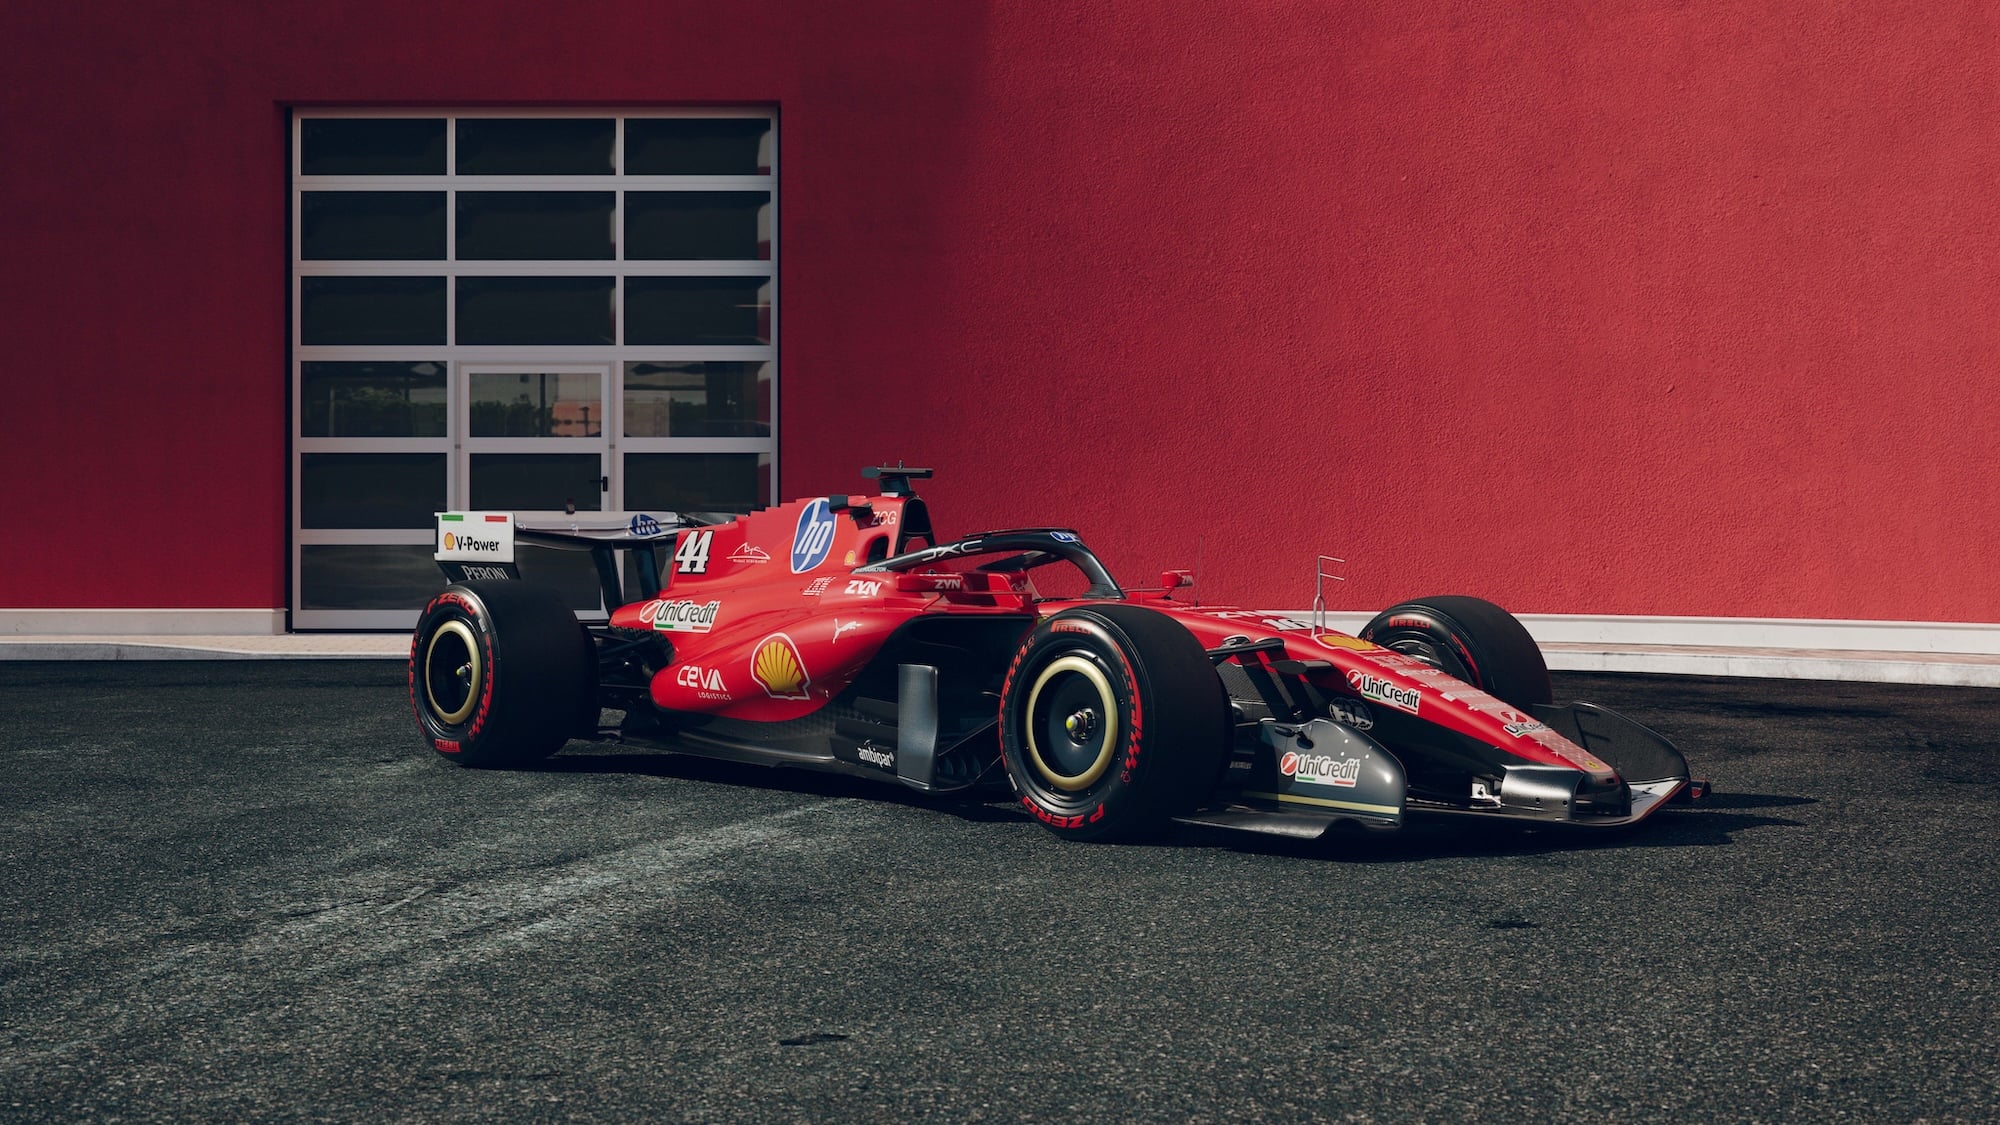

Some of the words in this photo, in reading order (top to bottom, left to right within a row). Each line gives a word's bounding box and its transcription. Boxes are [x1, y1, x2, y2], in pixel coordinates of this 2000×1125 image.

[871, 511, 897, 525] ZCG
[456, 536, 499, 551] V-Power
[795, 499, 832, 571] hp
[675, 530, 713, 573] 44
[461, 565, 510, 581] PERONI
[845, 580, 881, 597] ZYN
[934, 579, 961, 590] ZYN
[656, 602, 718, 625] UniCredit
[1389, 615, 1431, 629] PIRELLI
[1051, 619, 1092, 635] PIRELLI
[697, 691, 732, 701] LOGISTICS
[1362, 674, 1420, 708] UniCredit
[1297, 755, 1358, 779] UniCredit
[1022, 795, 1085, 828] ZERO
[1089, 802, 1105, 823] P
